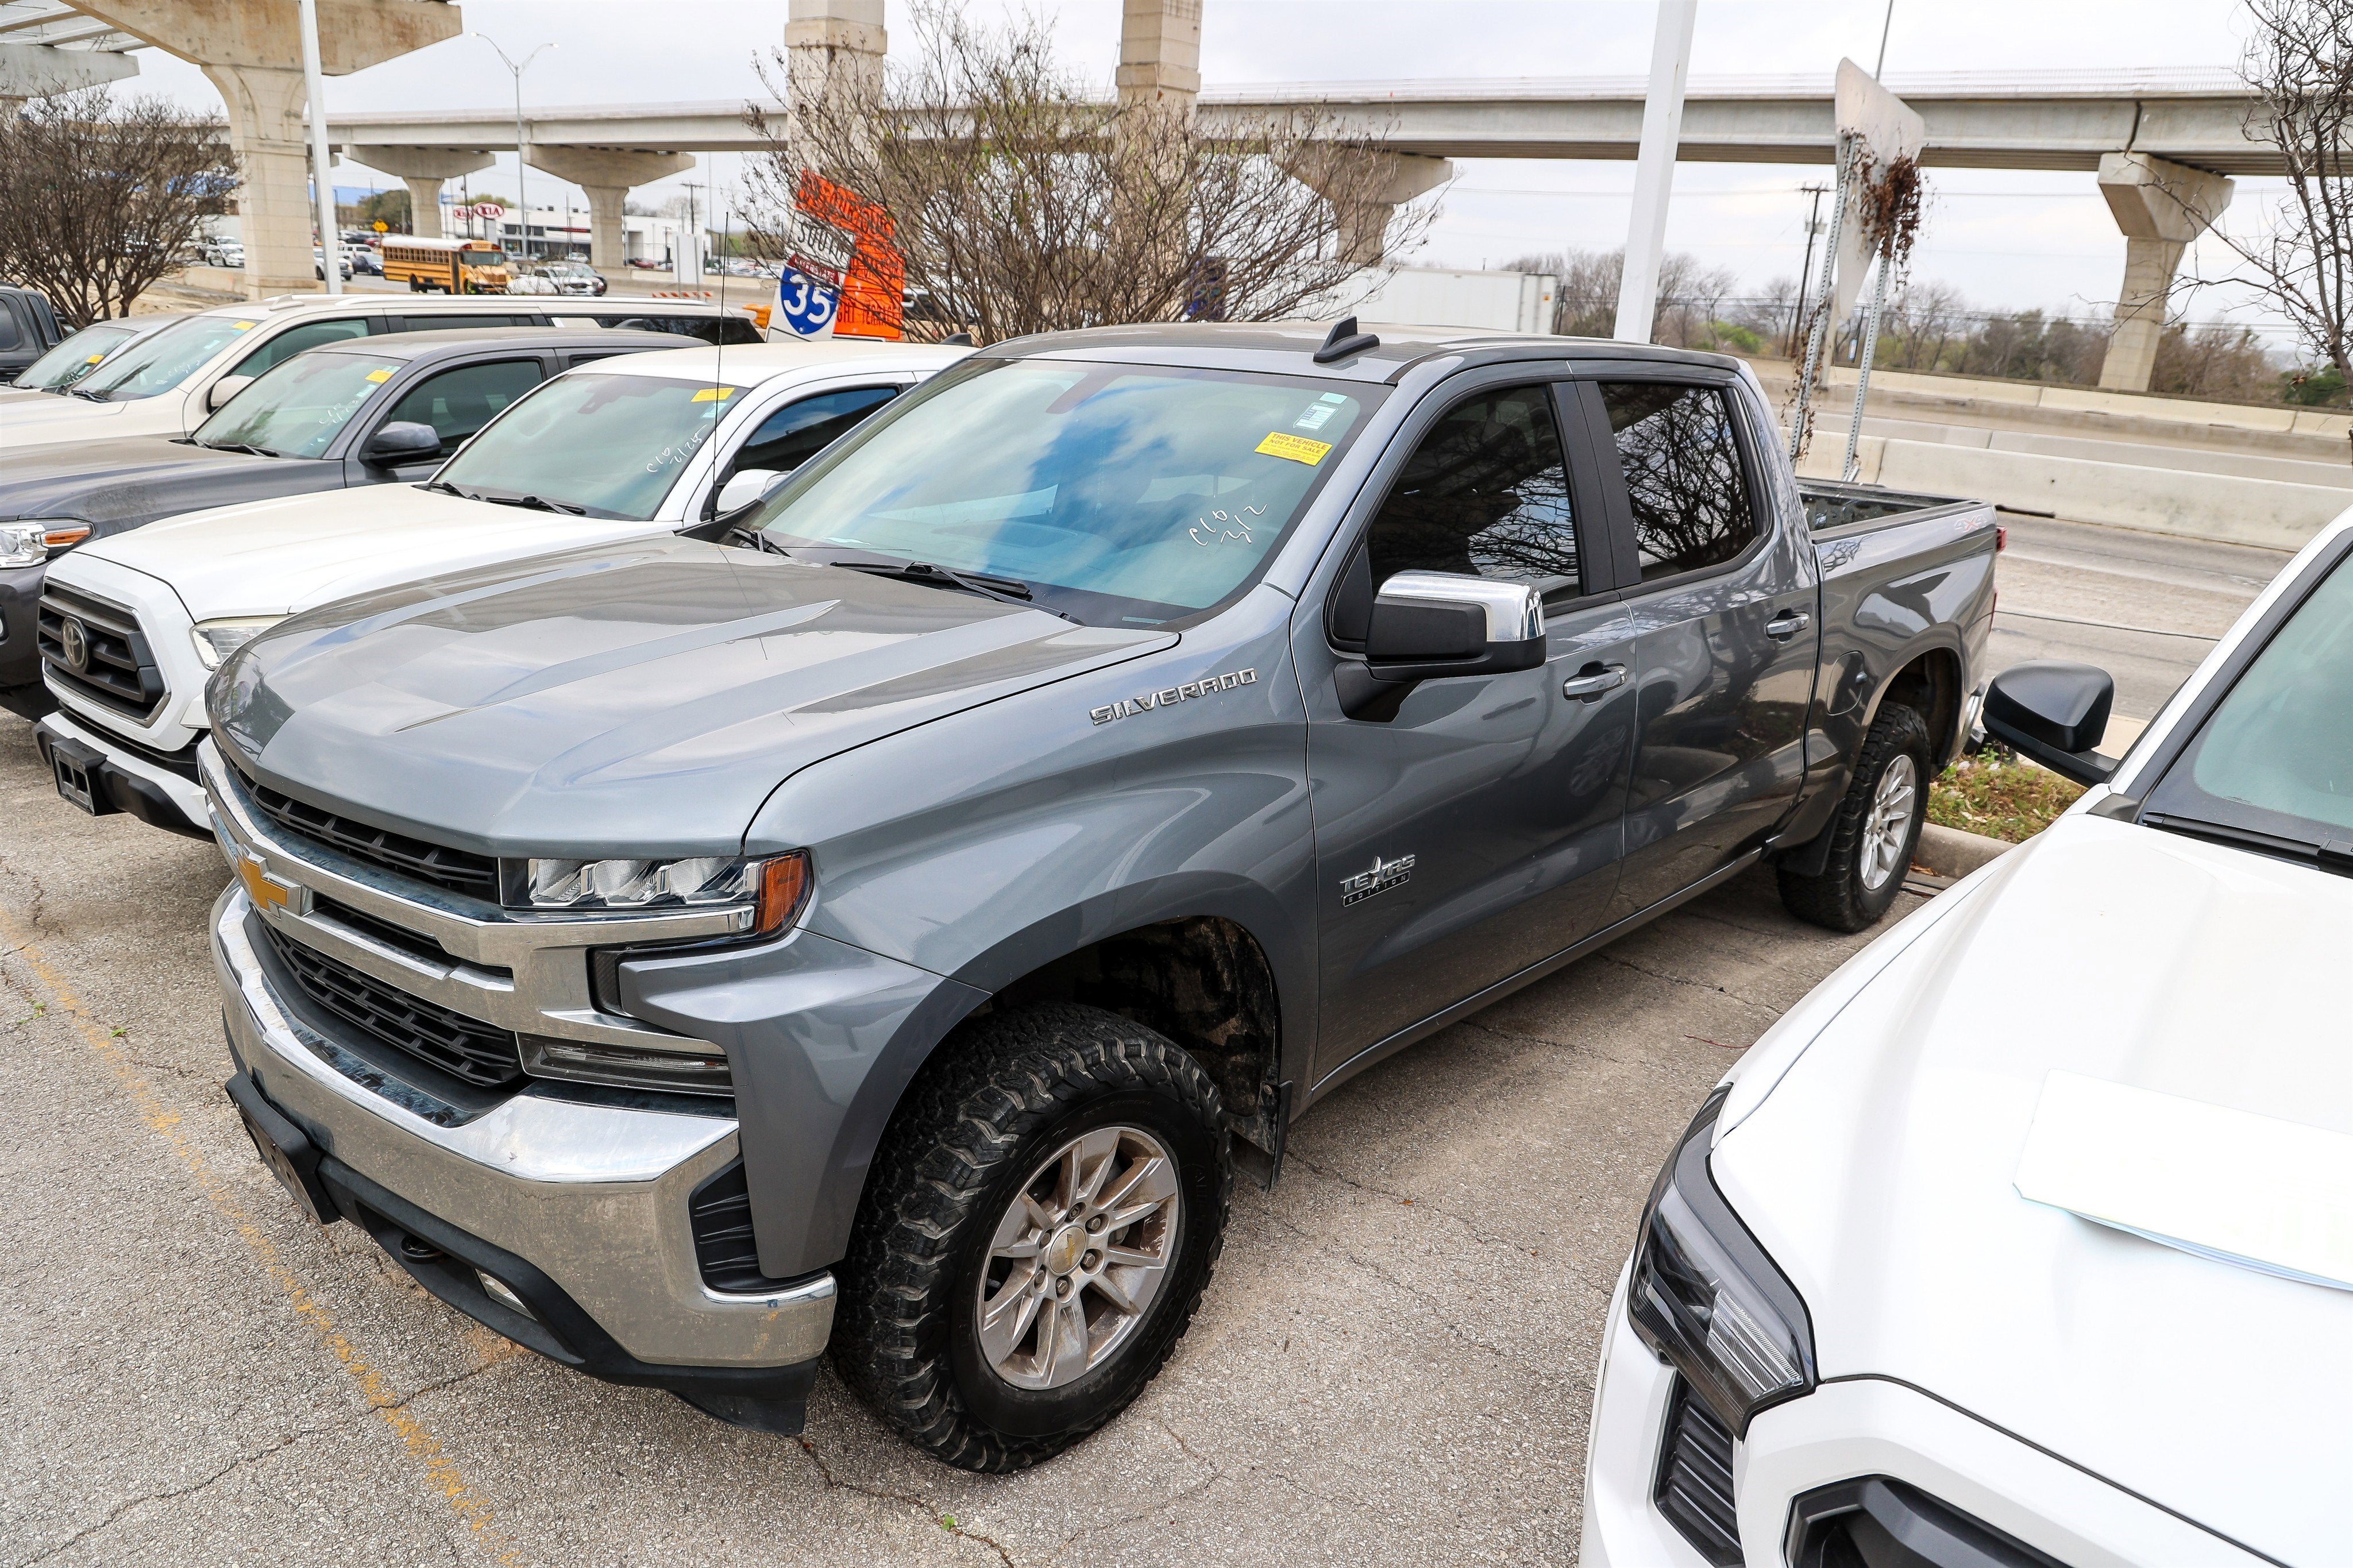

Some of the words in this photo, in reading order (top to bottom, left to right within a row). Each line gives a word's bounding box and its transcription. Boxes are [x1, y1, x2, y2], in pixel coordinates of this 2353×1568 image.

[475, 203, 504, 218] KIA
[783, 273, 833, 325] 35
[1271, 434, 1291, 442] THIS
[1293, 438, 1328, 450] VEHICLE
[1089, 667, 1258, 726] SILVERADO
[1340, 854, 1415, 893] TEXAS
[1349, 875, 1406, 903] EDITION
